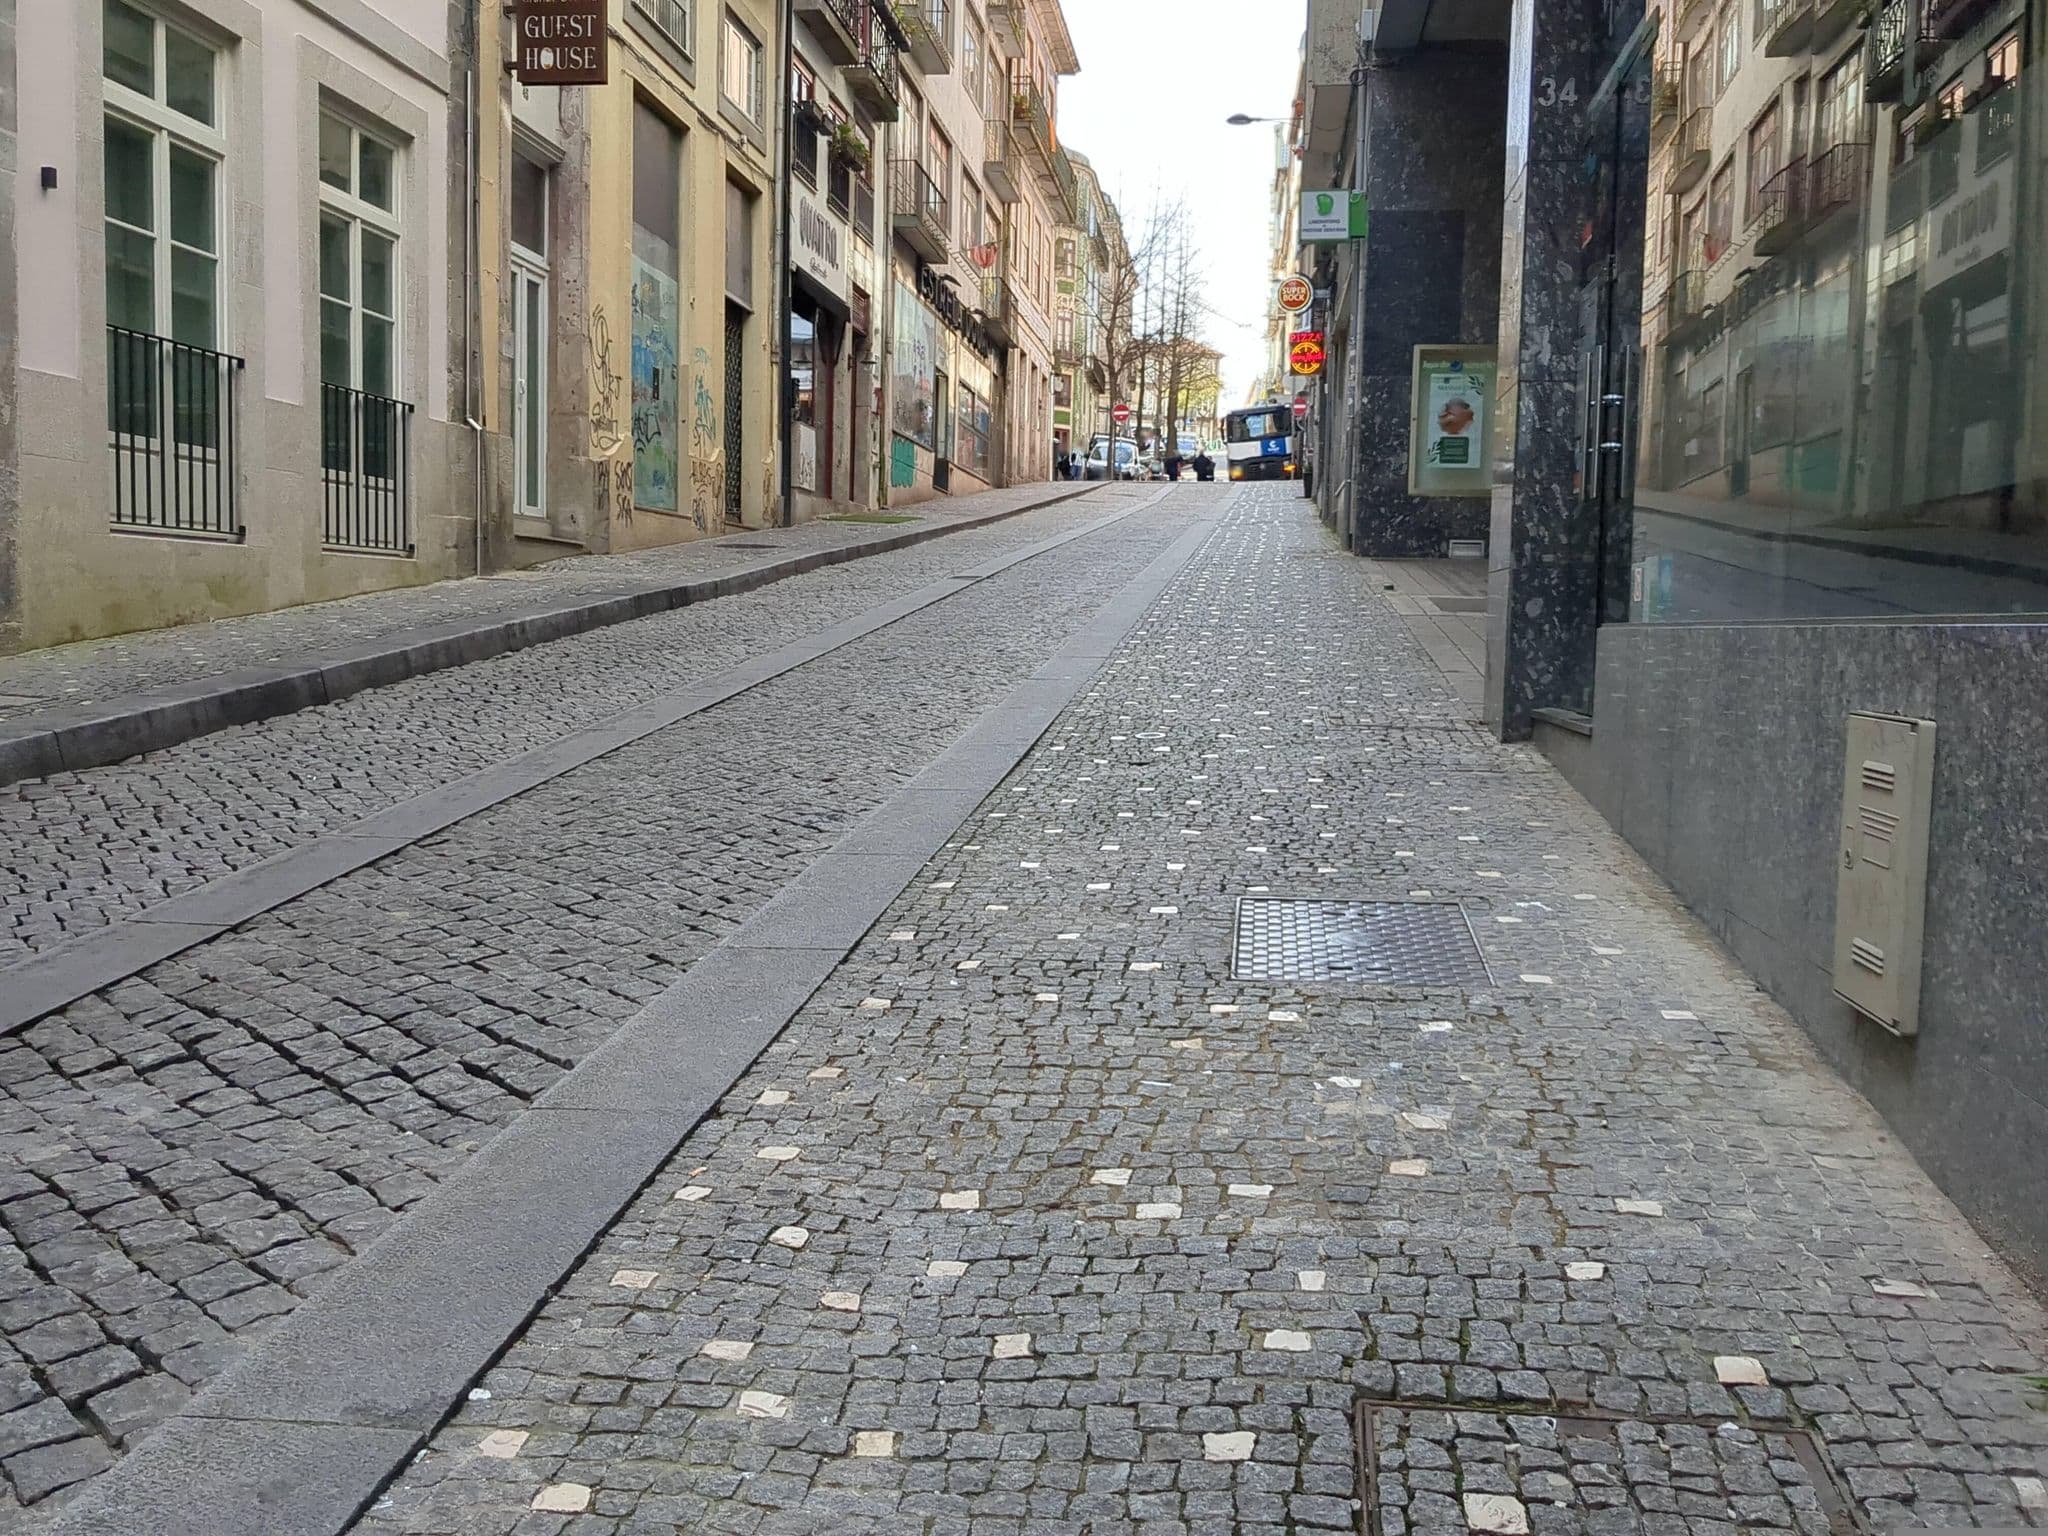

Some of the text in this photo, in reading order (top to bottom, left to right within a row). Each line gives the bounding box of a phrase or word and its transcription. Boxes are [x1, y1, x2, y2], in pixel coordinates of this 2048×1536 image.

[524, 15, 597, 39] GUEST
[525, 47, 597, 70] HOUSE
[1538, 77, 1578, 107] 34
[1282, 287, 1306, 295] SUPER
[1283, 294, 1305, 302] BOCK
[1290, 334, 1322, 342] PIZZA
